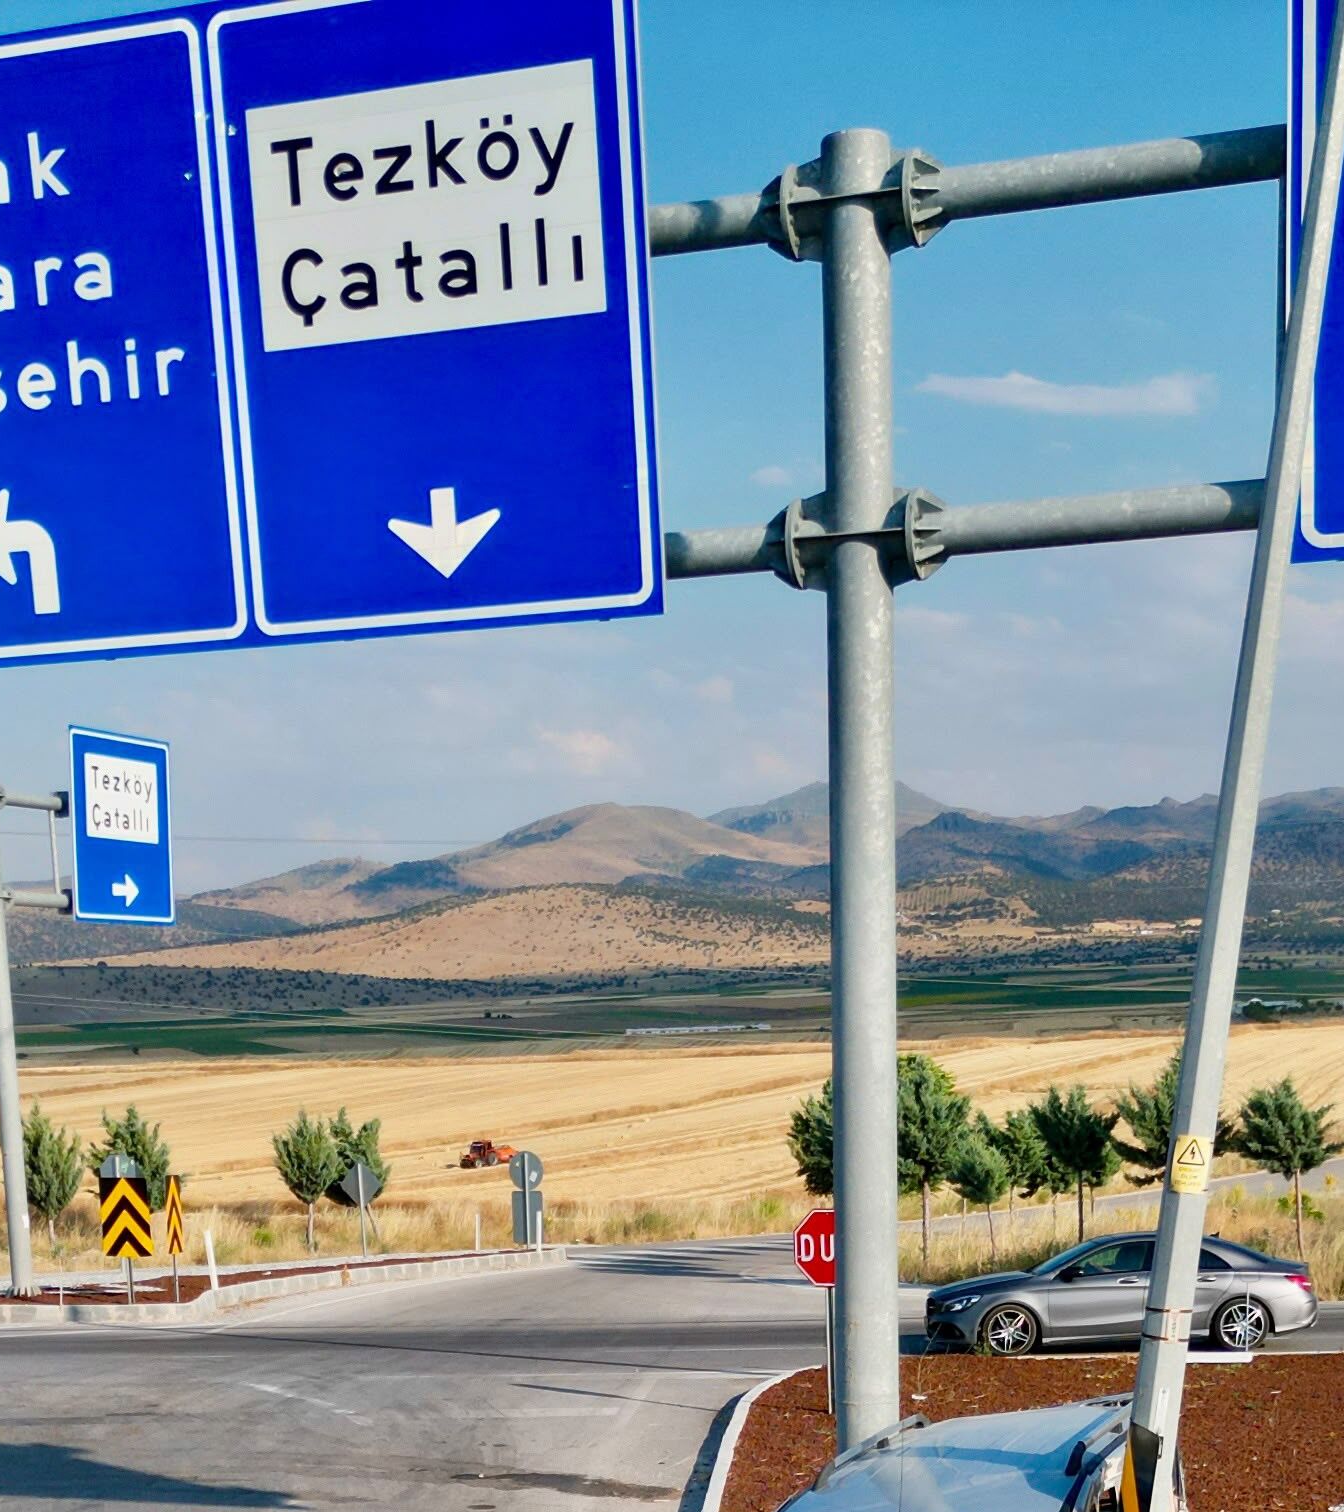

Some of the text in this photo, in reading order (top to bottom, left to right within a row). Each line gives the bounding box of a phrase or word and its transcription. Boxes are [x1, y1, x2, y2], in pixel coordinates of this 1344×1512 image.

[269, 113, 576, 207] Tezköy
[281, 217, 585, 327] Çatallı
[91, 765, 153, 804] Tezköy
[92, 803, 149, 833] Çatallı
[800, 1233, 835, 1263] DU
